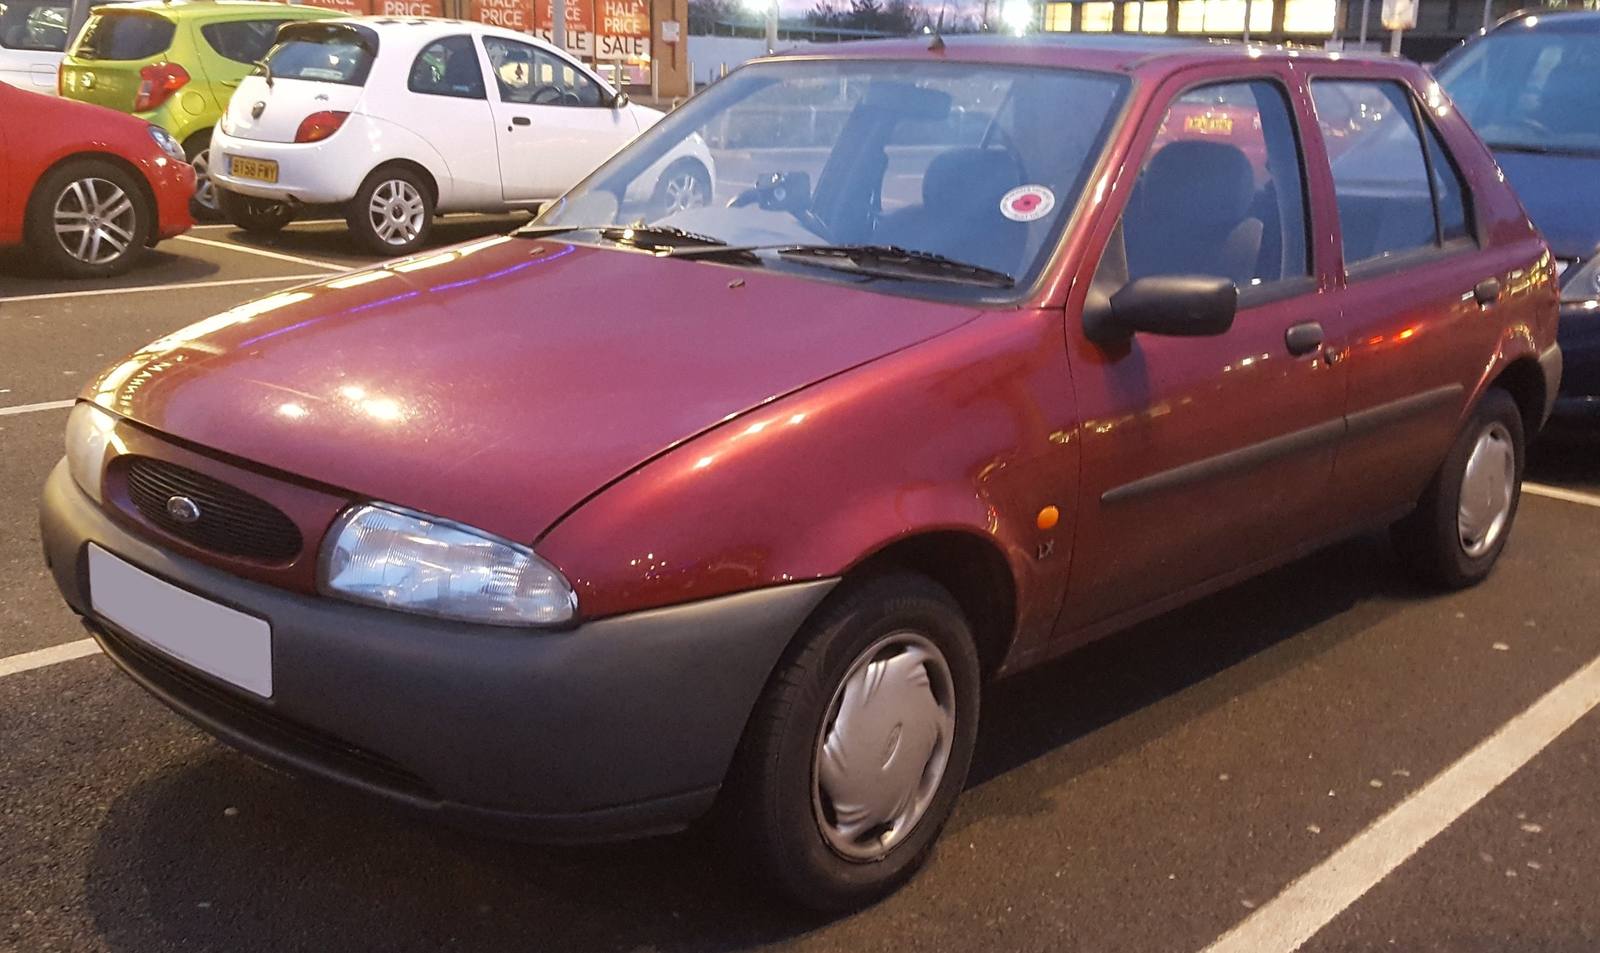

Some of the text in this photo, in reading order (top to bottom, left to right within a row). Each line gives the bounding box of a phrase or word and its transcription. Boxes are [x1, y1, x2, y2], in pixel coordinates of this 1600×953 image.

[384, 0, 432, 17] PRICE
[480, 8, 523, 26] PRICE
[605, 0, 640, 17] HALF
[604, 16, 641, 34] PRICE
[542, 29, 586, 50] SLE
[602, 35, 643, 56] SALE
[1036, 539, 1055, 561] LX
